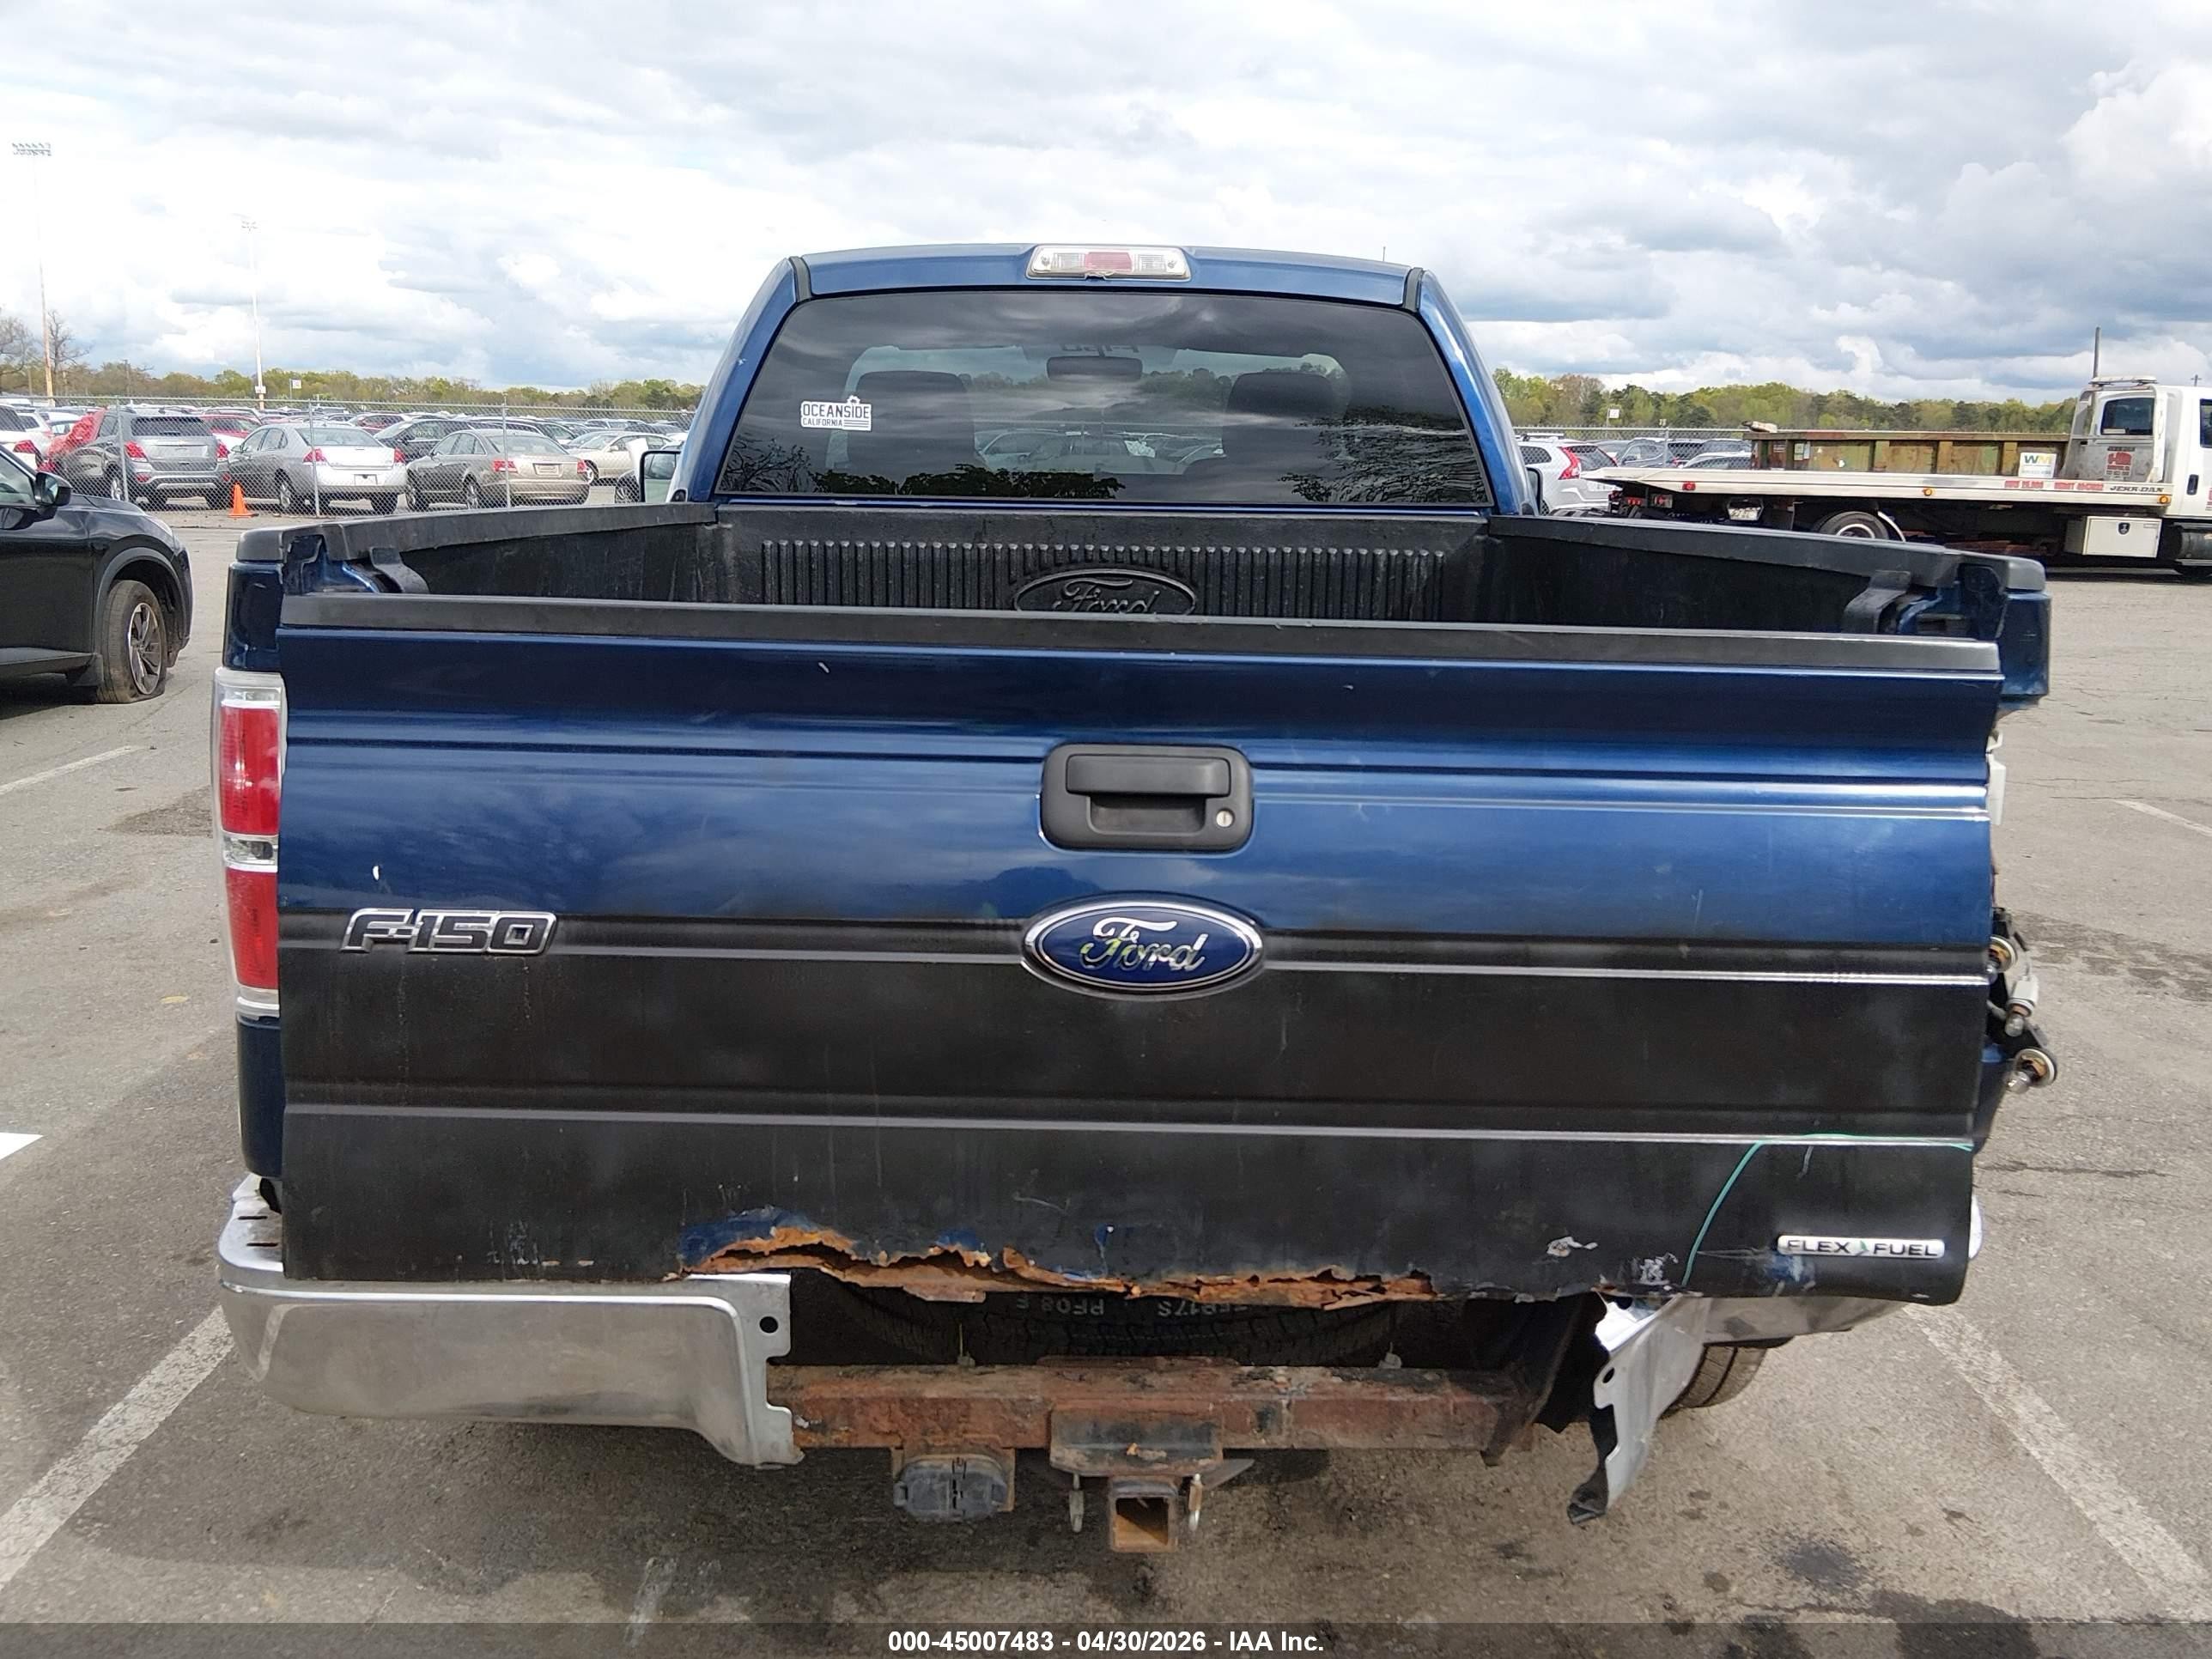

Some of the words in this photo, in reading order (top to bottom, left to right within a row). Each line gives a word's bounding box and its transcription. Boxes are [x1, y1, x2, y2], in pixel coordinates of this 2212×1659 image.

[803, 404, 870, 418] OCEANSIDE
[803, 417, 843, 427] CALIFORNIA
[2024, 455, 2051, 464] WM
[341, 908, 557, 955] F-150
[1079, 916, 1209, 972] Ford
[1786, 1239, 1850, 1255] FLEX
[1873, 1243, 1939, 1257] FUEL
